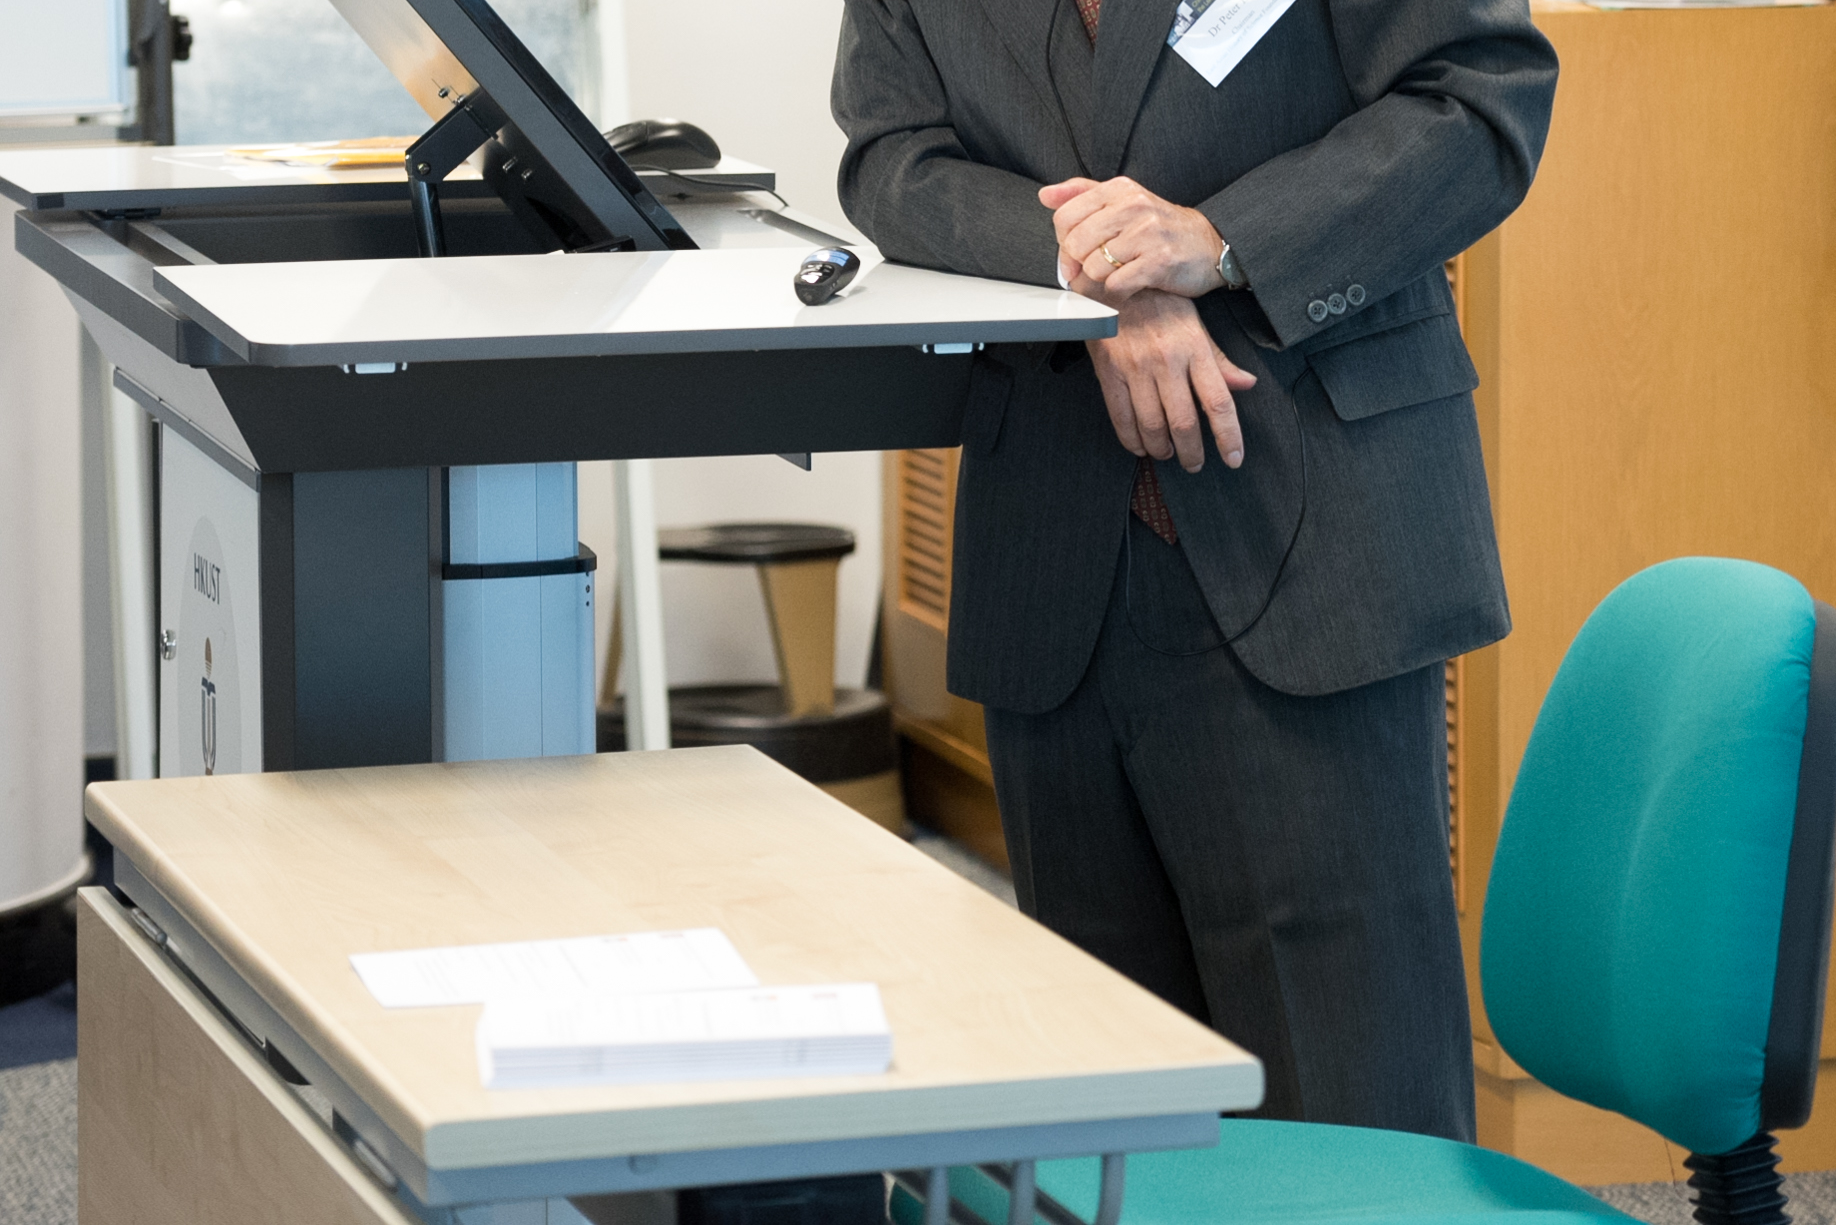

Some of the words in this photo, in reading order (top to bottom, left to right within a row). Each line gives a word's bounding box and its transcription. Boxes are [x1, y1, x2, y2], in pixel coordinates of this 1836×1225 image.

[1207, 21, 1222, 37] Dr
[1218, 1, 1241, 25] Peter
[1230, 8, 1255, 35] Chairman
[194, 552, 221, 605] HKUST
